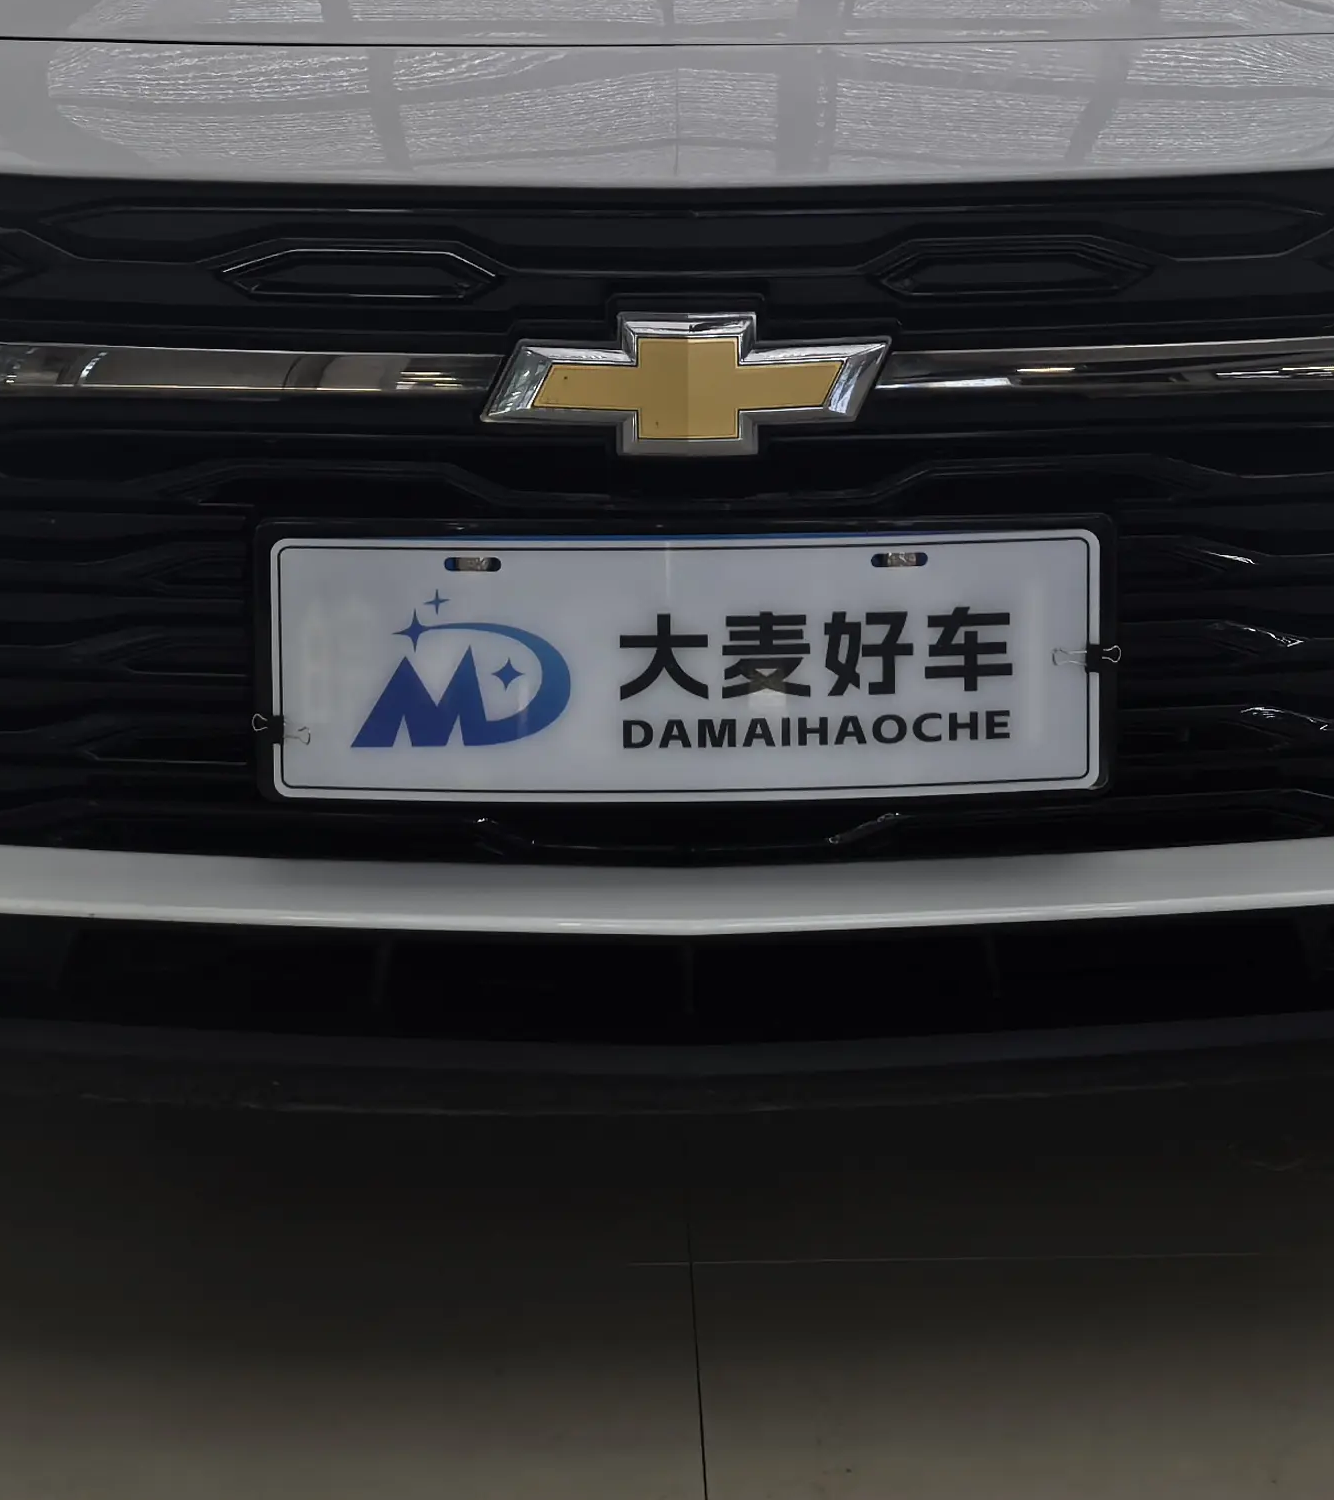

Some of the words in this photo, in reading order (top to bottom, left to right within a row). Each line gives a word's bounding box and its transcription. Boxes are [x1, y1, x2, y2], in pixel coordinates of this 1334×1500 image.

[617, 606, 1013, 701] 大麦好车
[622, 709, 1012, 750] DAMAIHAOCHE
